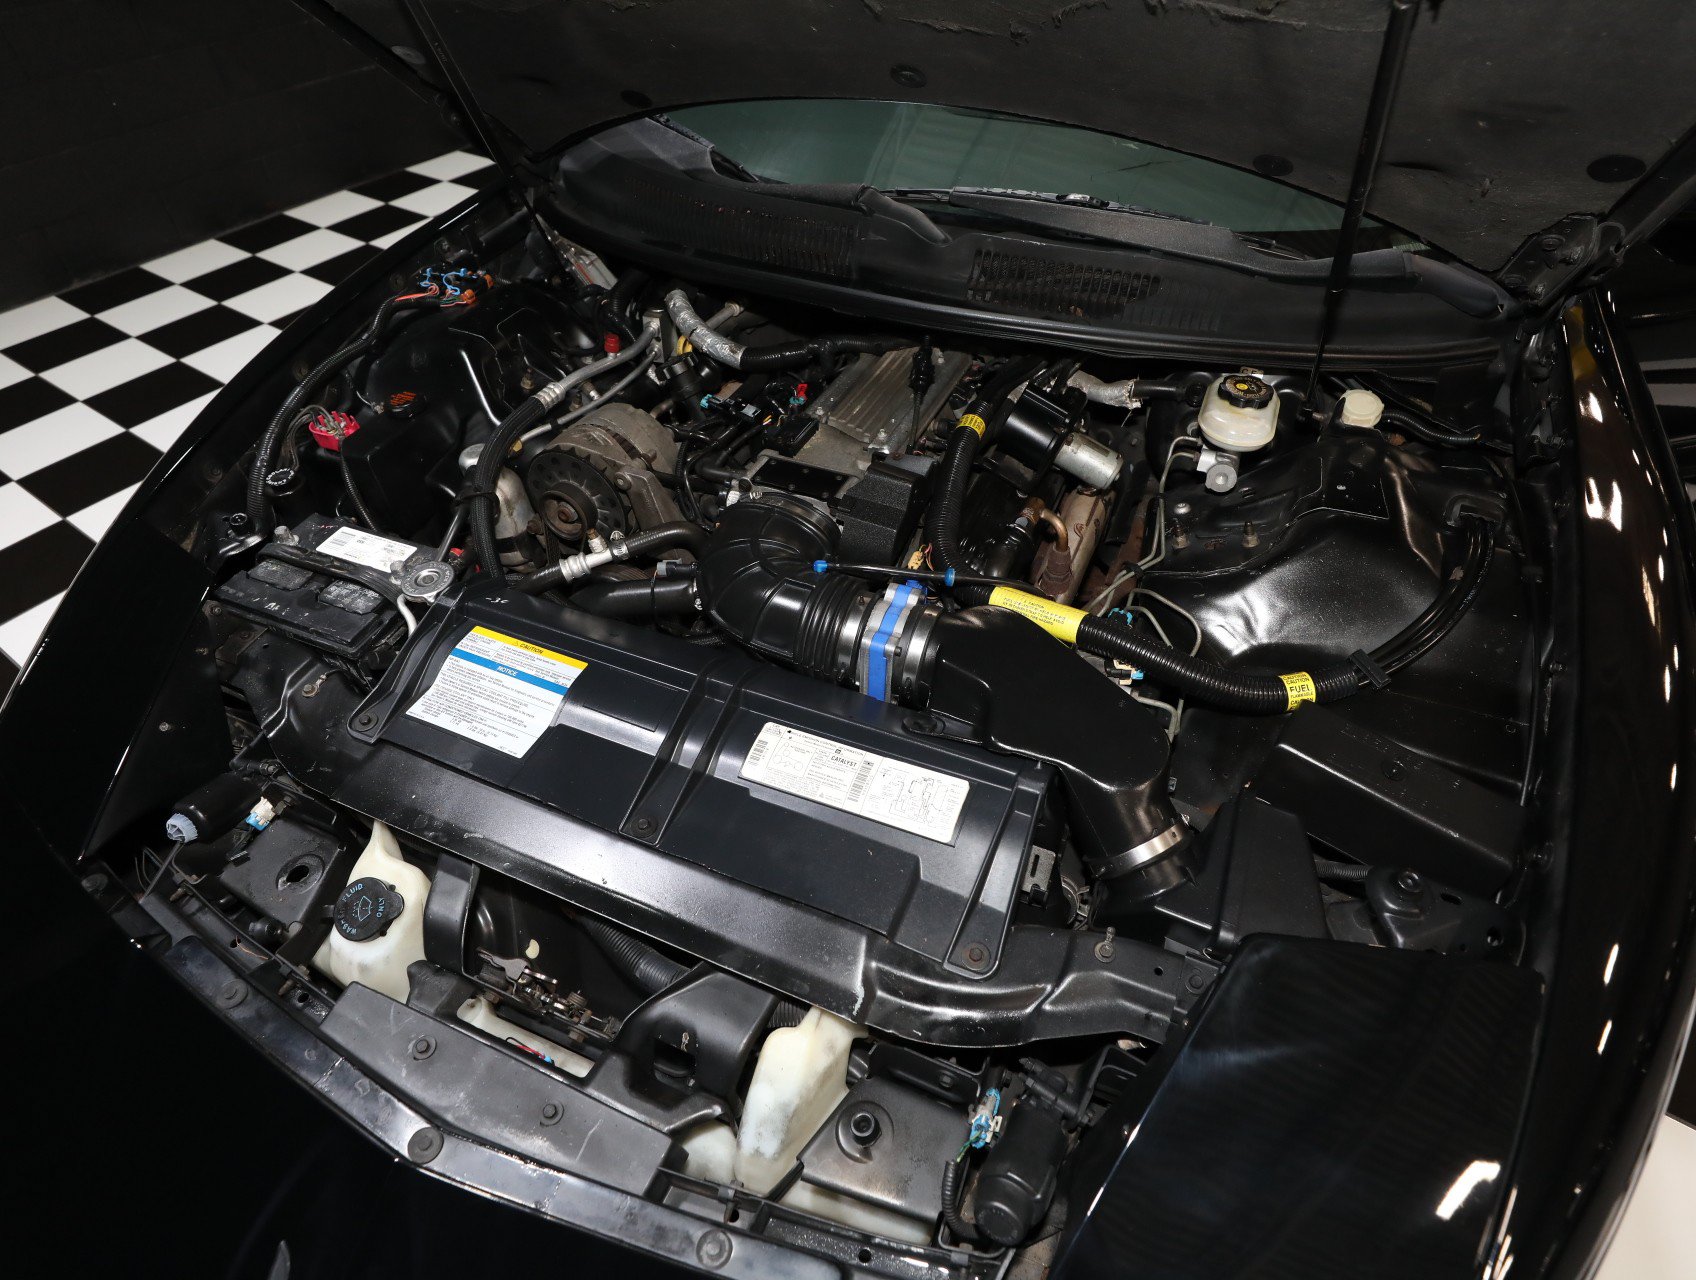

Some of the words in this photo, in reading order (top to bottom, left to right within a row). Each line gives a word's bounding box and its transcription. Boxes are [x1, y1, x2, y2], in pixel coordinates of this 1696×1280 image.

[520, 642, 544, 655] CAUTION
[497, 665, 519, 677] NOTICE
[1286, 677, 1310, 685] CAUTION
[1289, 684, 1312, 693] FUEL
[831, 755, 858, 767] CATALYST
[342, 883, 363, 902] FLUID
[376, 898, 385, 918] ONLY
